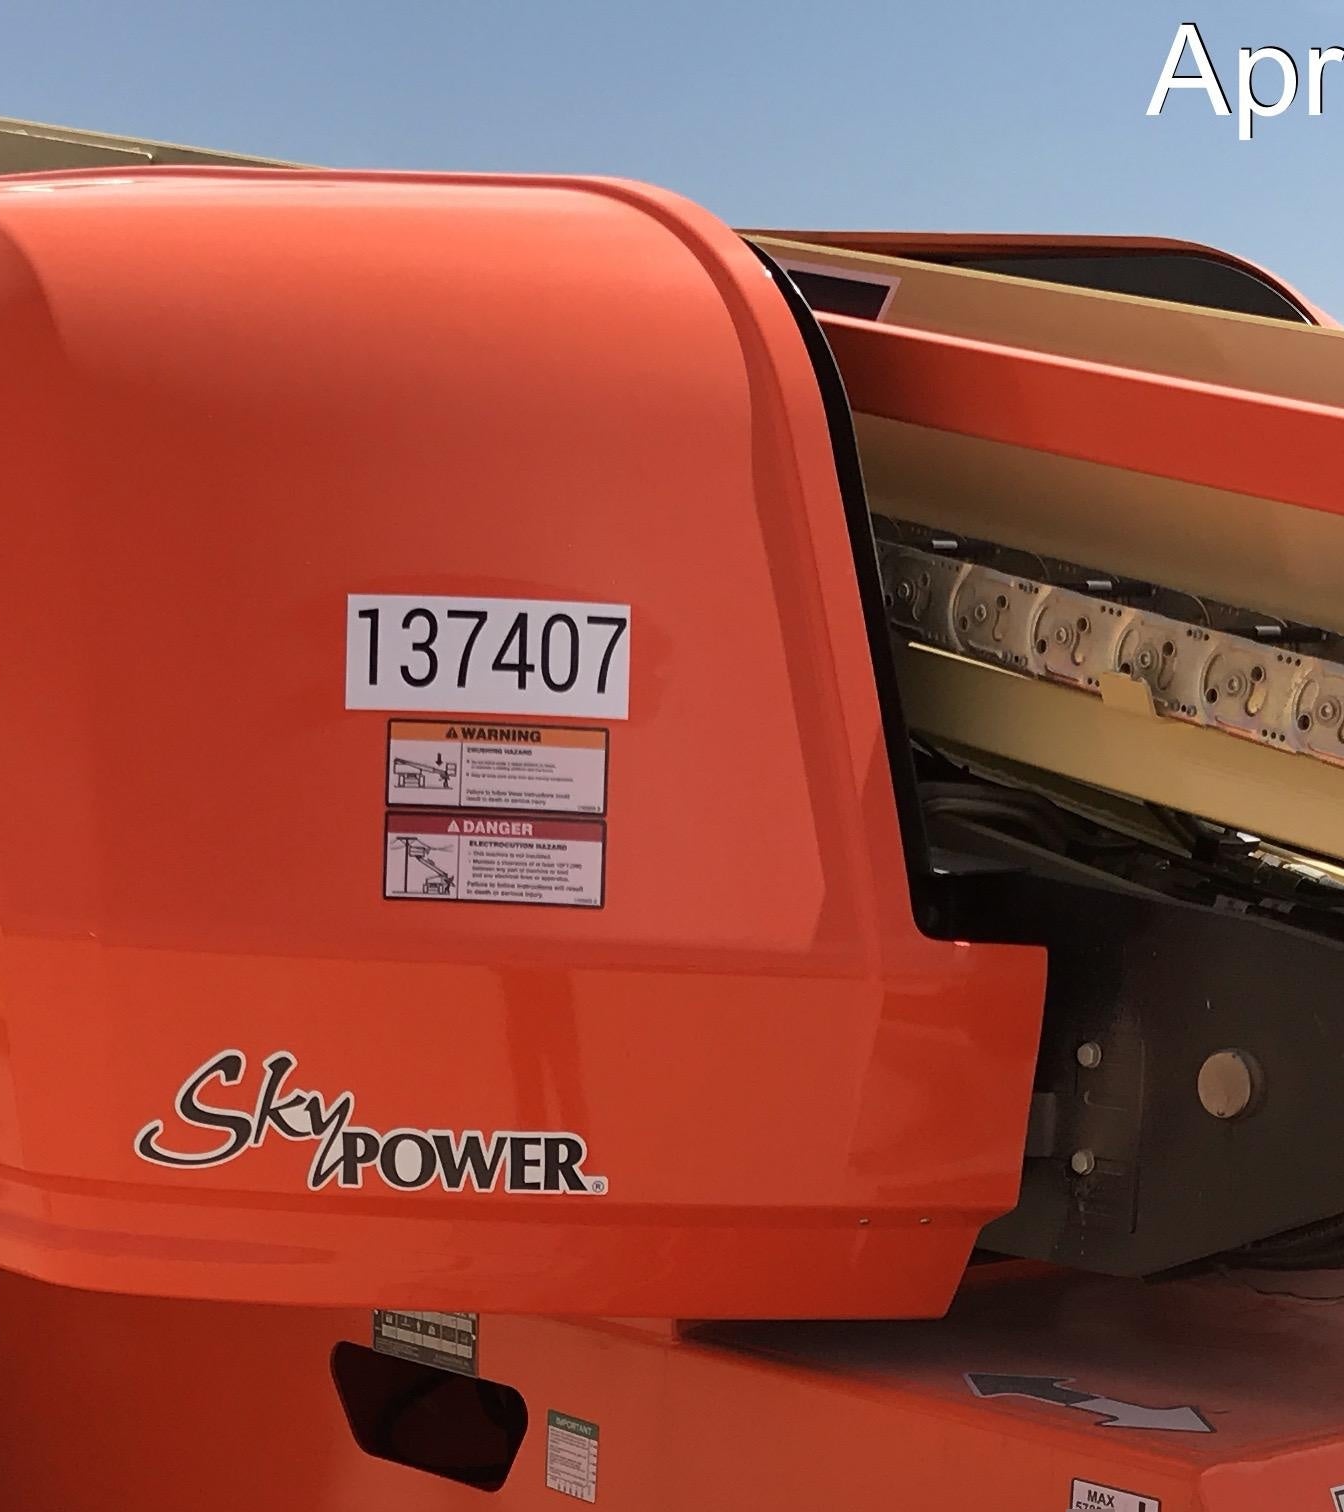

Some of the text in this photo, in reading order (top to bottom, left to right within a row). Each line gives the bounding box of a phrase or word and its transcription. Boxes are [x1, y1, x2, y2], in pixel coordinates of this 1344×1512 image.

[358, 607, 627, 694] 137407
[461, 727, 542, 743] WARNING
[463, 820, 534, 836] DANGER
[139, 1053, 354, 1188] Sky
[341, 1131, 587, 1192] POWER
[556, 1416, 593, 1437] IMPORTANT
[1087, 1489, 1115, 1508] MAX
